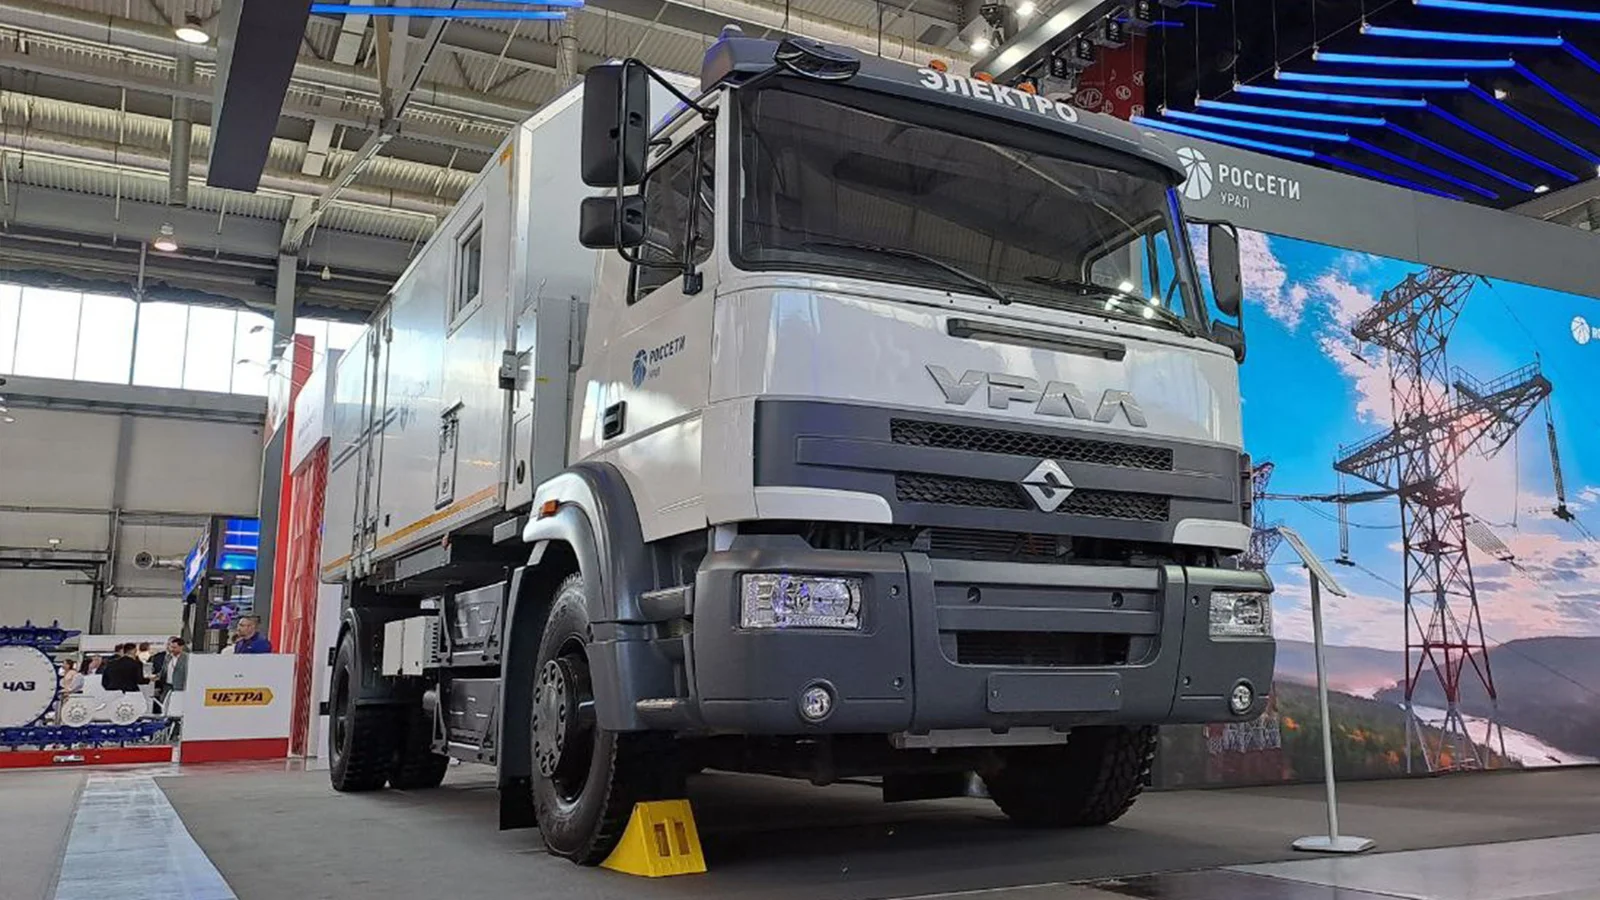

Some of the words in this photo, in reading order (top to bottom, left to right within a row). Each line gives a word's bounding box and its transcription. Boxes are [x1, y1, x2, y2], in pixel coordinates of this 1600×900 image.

[917, 68, 1079, 123] ЭЛЕКТРО
[1218, 163, 1300, 200] РОССЕТИ
[1220, 191, 1250, 209] УРАЛ
[648, 335, 686, 365] РОССЕТИ
[925, 364, 1148, 428] УРАЛ
[3, 681, 36, 692] ЧАЗ
[212, 691, 264, 703] ЧЕТРА
